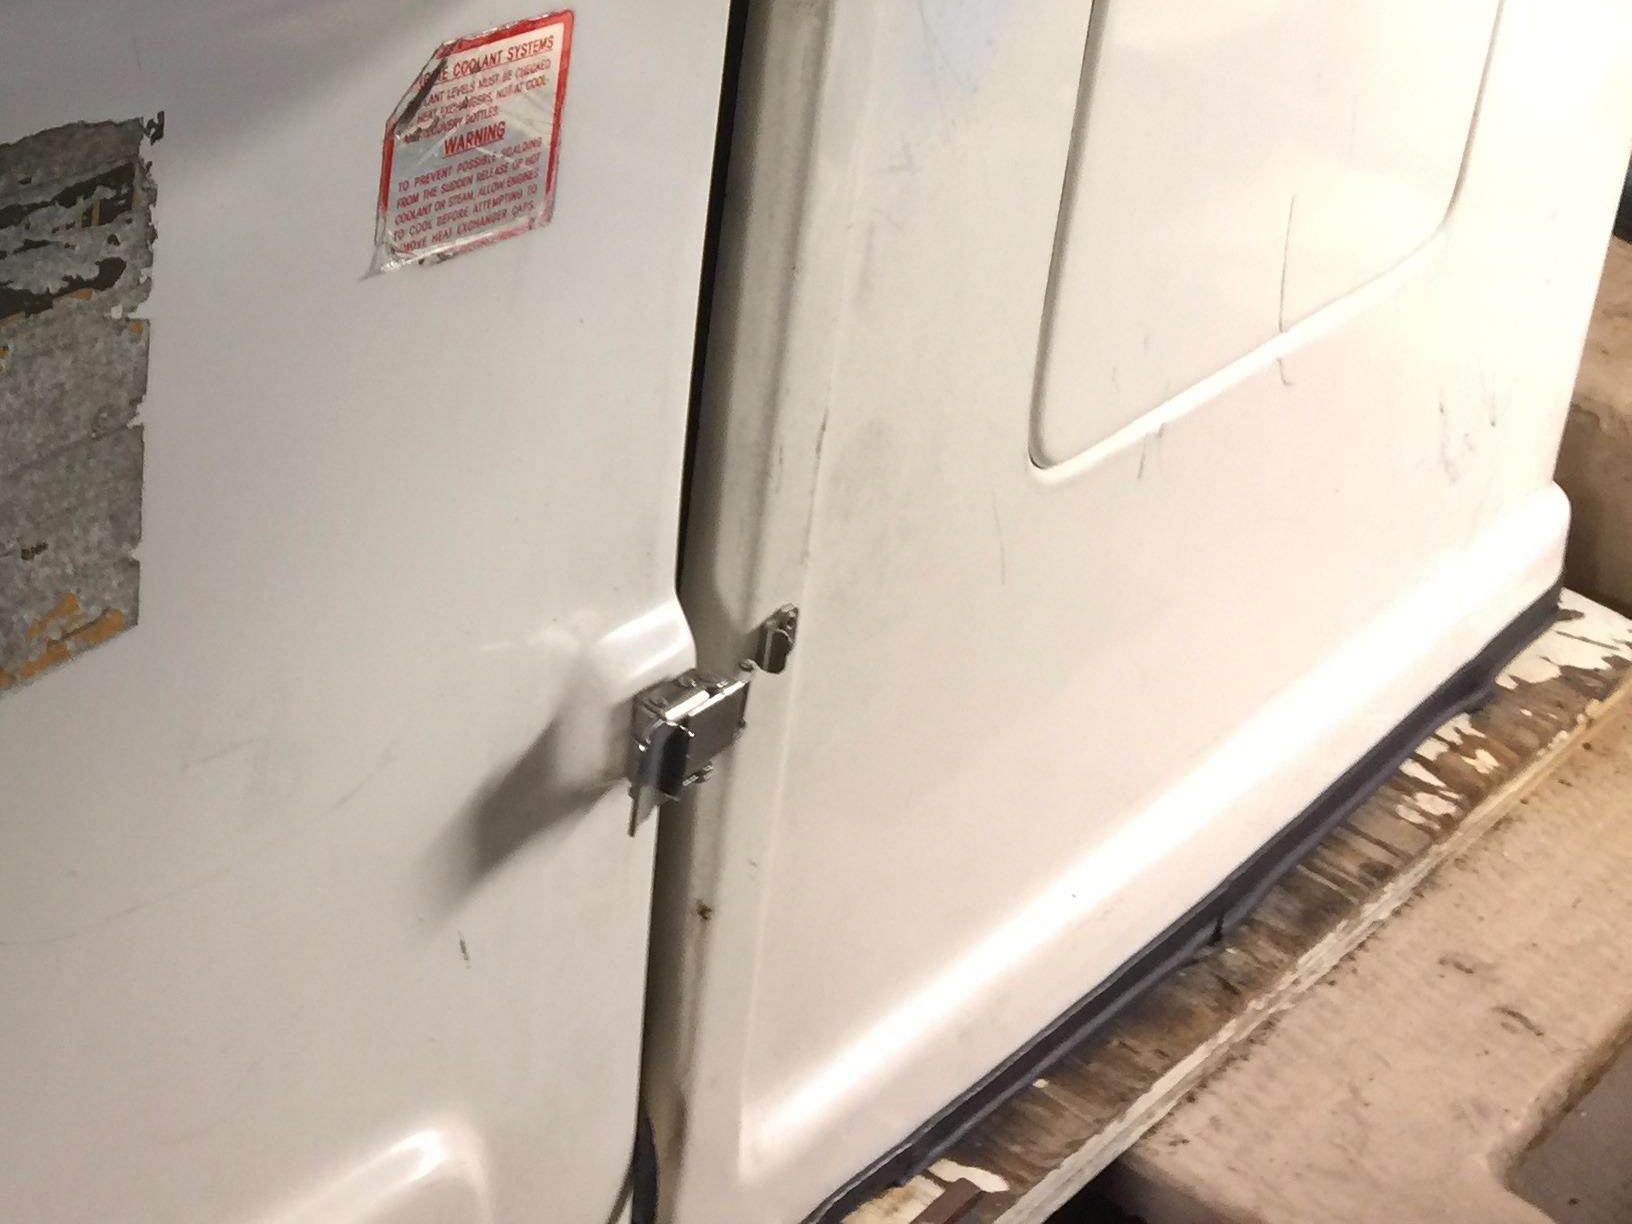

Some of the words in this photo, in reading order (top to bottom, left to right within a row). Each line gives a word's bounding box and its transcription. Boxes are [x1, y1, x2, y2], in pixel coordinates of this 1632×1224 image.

[453, 49, 503, 77] COOLANT
[506, 35, 555, 61] SYSTEMS
[443, 121, 506, 156] WARNING
[396, 192, 420, 209] FROM
[423, 186, 437, 200] THE
[441, 175, 474, 194] SUDDEN
[476, 162, 509, 182] RELEASE
[511, 157, 524, 171] OF
[398, 180, 410, 192] TO
[414, 166, 453, 187] PREVENT
[393, 228, 405, 242] TO
[409, 220, 432, 236] COOL
[436, 207, 469, 227] BEFORE
[527, 183, 538, 196] TO
[394, 203, 433, 225] COOLANT
[434, 199, 446, 212] OR
[477, 178, 506, 198] ALLOW
[431, 227, 453, 244] HEAT
[456, 209, 508, 235] EXCHANGER
